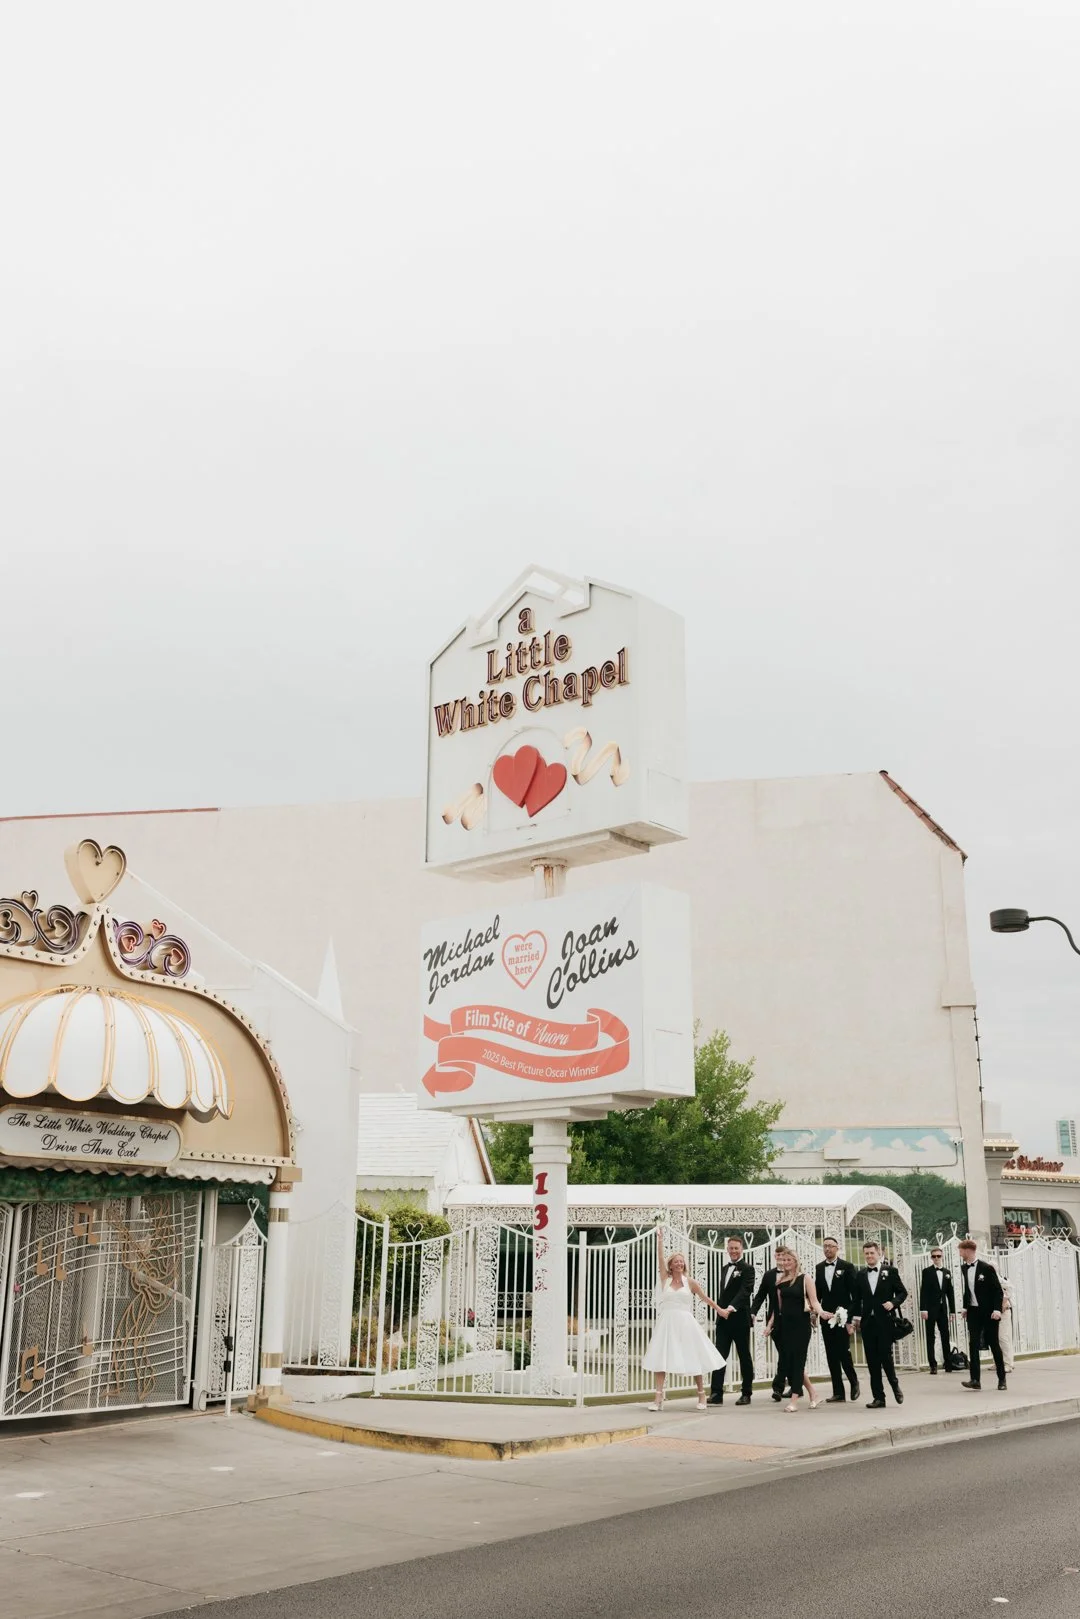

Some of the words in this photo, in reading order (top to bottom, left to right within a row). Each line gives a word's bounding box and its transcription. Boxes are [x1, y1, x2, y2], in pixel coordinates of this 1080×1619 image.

[517, 607, 536, 635] a
[486, 630, 572, 685] Little
[434, 689, 516, 737] White
[522, 647, 630, 712] Chapel
[423, 914, 500, 972] Michael
[508, 950, 540, 965] married
[514, 942, 533, 952] were
[561, 916, 619, 975] Joan
[428, 951, 494, 1005] Jordan
[514, 965, 532, 976] here
[546, 940, 639, 1009] Collins
[465, 1010, 490, 1027] Film
[493, 1012, 515, 1032] Site
[516, 1021, 531, 1037] of
[482, 1048, 501, 1063] 2025
[501, 1056, 517, 1071] Best
[516, 1062, 544, 1077] Picture
[545, 1067, 568, 1078] Oscar
[569, 1064, 600, 1078] Winner
[7, 1112, 30, 1128] The
[33, 1114, 62, 1131] Little
[65, 1117, 93, 1134] White
[97, 1120, 136, 1142] Wedding
[139, 1124, 171, 1144] Chapel
[41, 1133, 78, 1153] Drive
[81, 1138, 113, 1156] Thru
[117, 1141, 140, 1158] Exit
[1003, 1210, 1035, 1224] HOTEL
